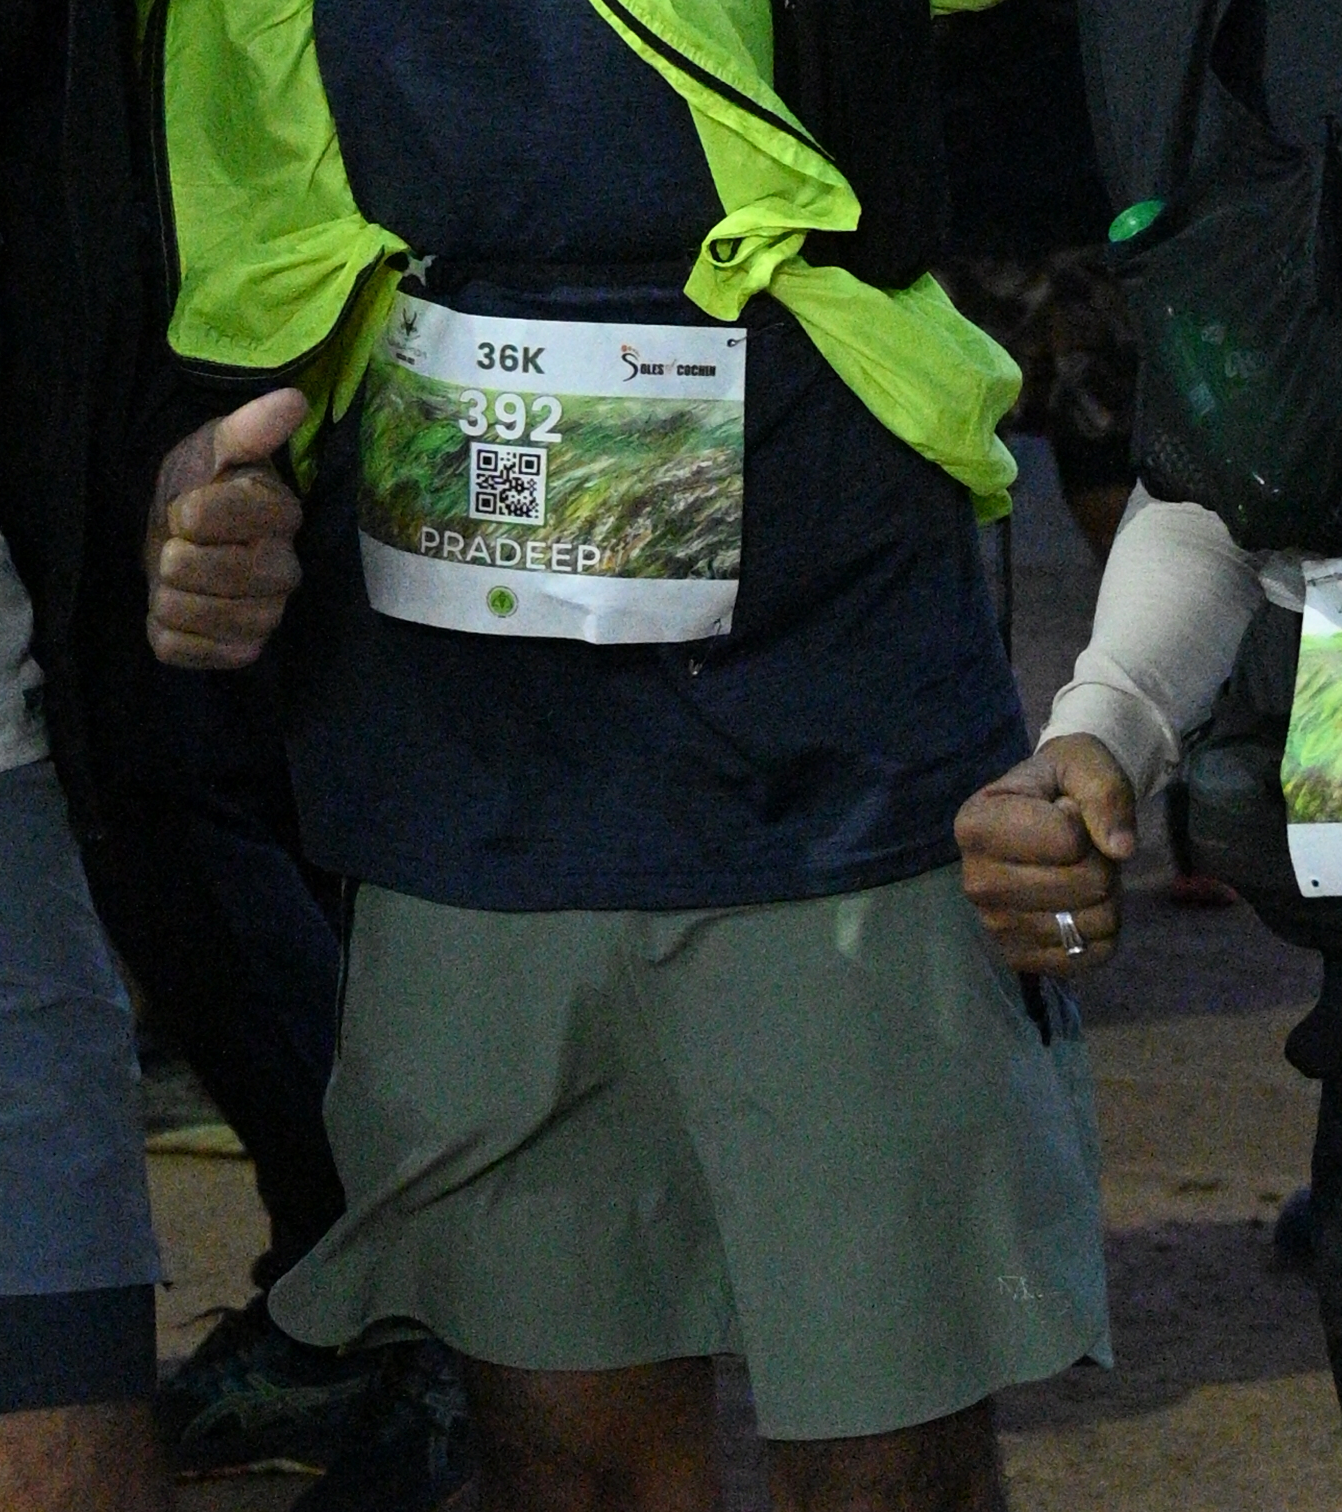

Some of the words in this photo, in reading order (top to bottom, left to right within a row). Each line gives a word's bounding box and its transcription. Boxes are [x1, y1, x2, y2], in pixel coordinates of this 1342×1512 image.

[476, 341, 546, 375] 36K
[459, 389, 563, 444] 392
[419, 526, 602, 574] PRADEEP
